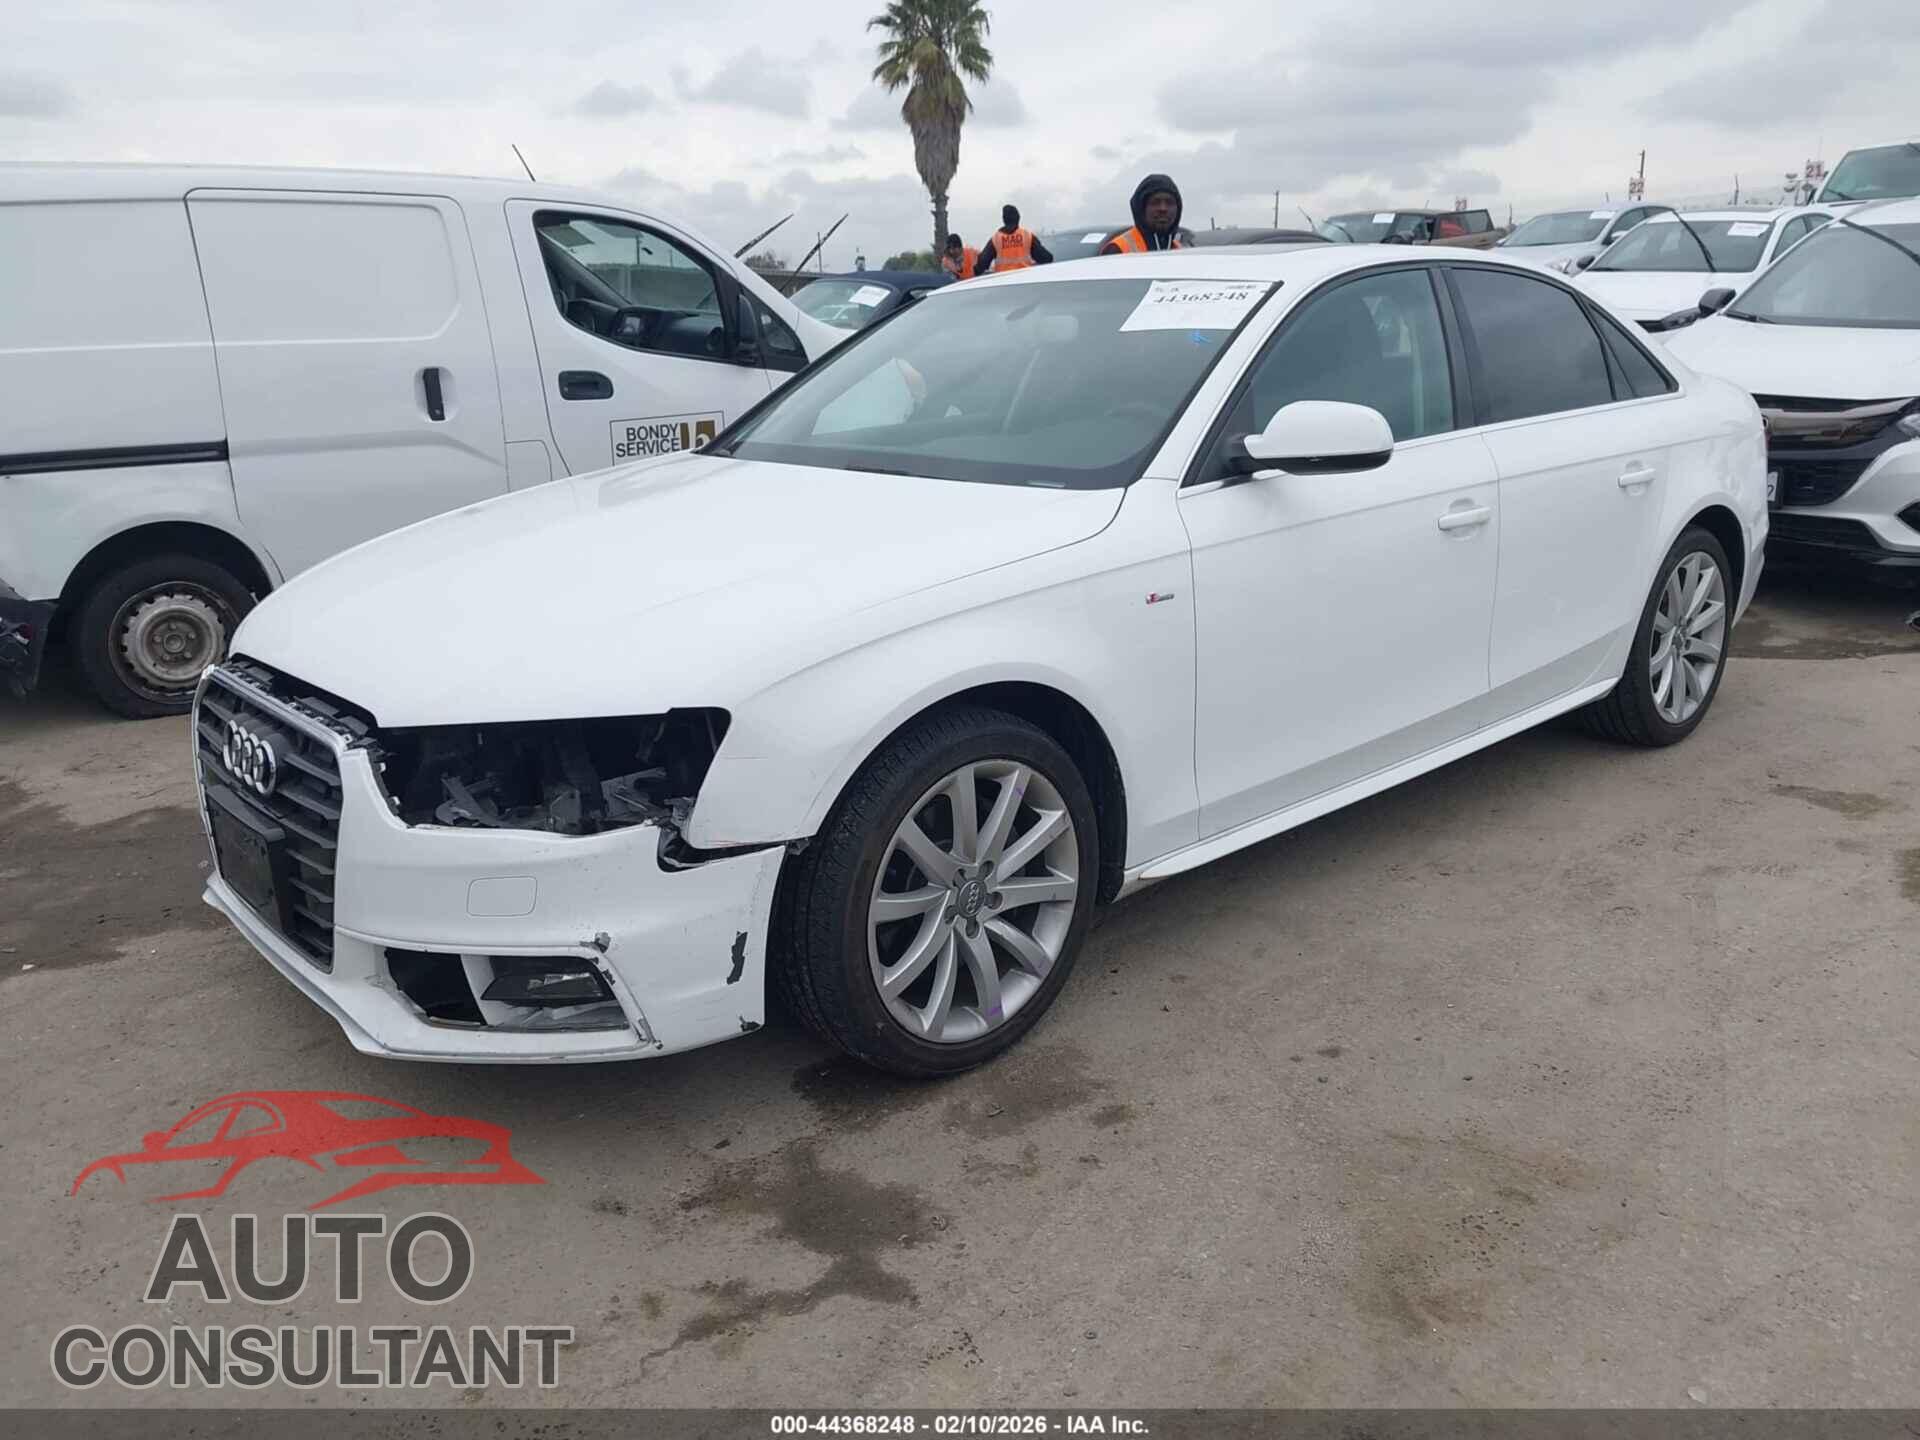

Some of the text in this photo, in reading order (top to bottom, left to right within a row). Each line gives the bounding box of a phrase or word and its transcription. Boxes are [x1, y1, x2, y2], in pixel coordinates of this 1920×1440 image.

[1154, 292, 1249, 304] 44368248
[626, 423, 678, 442] BONDY
[616, 438, 681, 458] SERVICE
